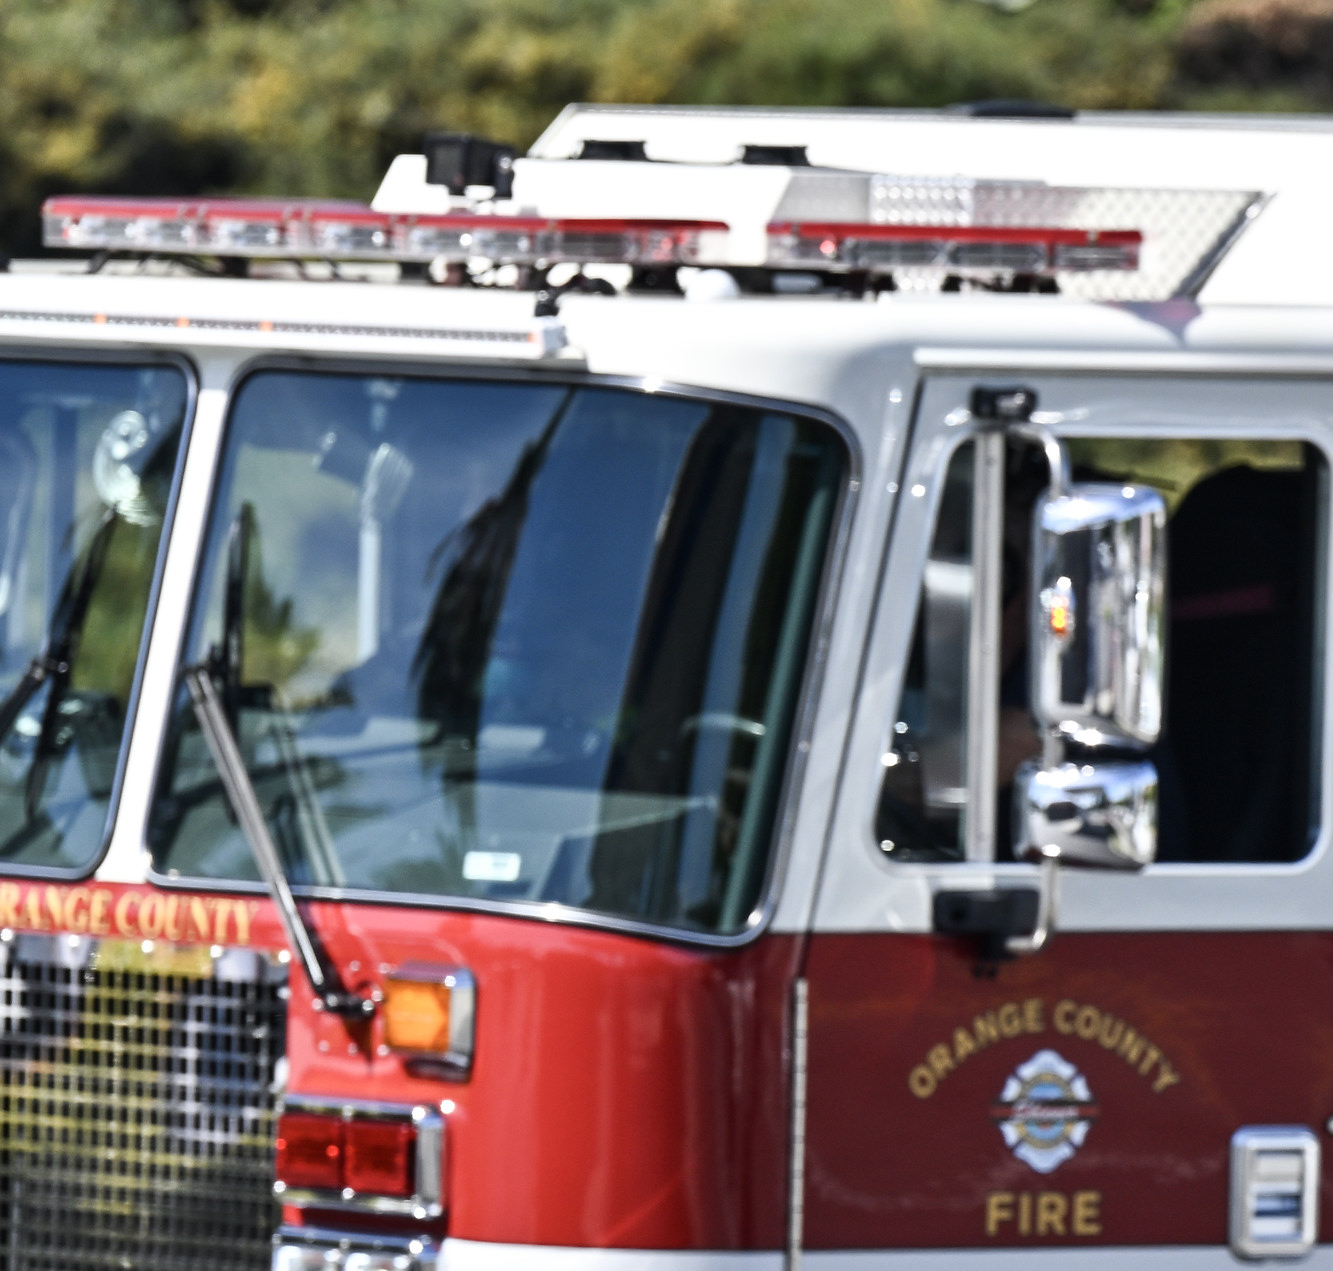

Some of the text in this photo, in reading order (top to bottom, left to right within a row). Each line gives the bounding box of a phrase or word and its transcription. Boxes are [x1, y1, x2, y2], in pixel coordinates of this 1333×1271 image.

[114, 890, 260, 947] COUNTY
[907, 998, 1182, 1100] ORANGE COUNTY
[984, 1191, 1102, 1237] FIRE
